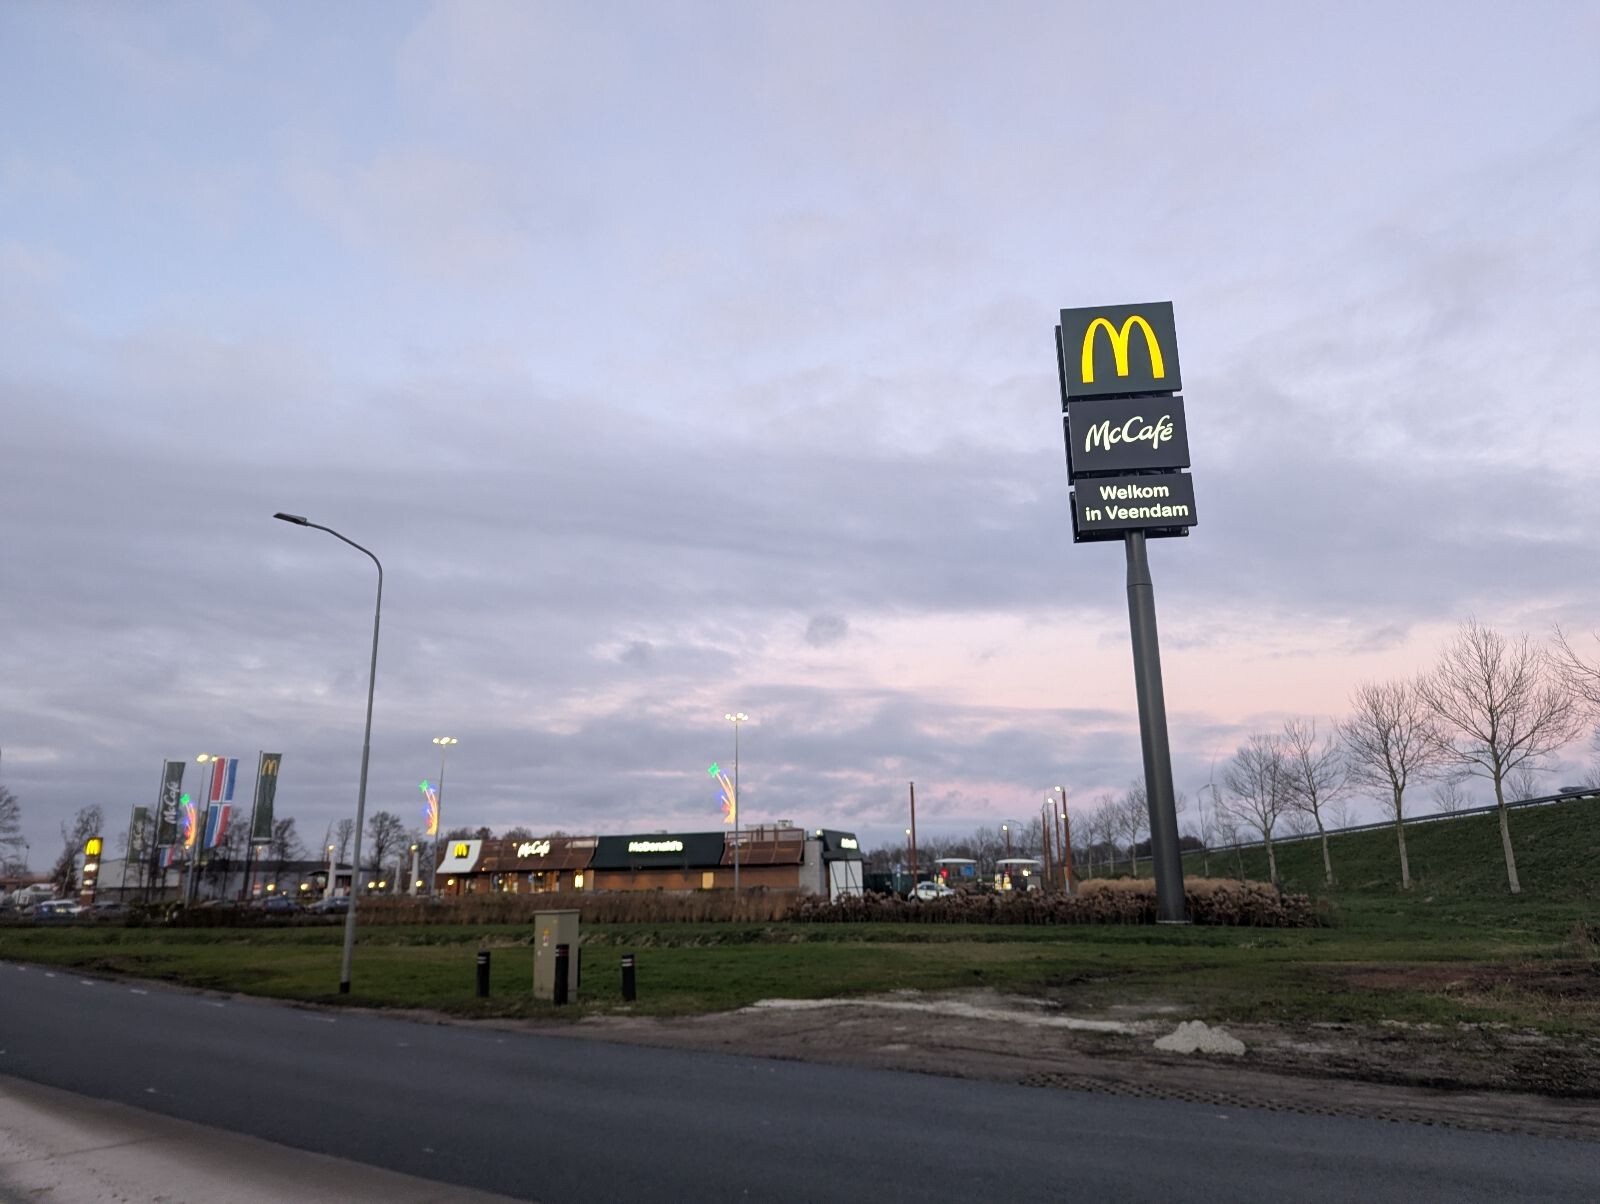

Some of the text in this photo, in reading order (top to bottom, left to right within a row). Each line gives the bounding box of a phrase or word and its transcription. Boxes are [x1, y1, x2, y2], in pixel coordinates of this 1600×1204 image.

[1085, 415, 1173, 452] McCafé
[1100, 484, 1169, 500] Welkom
[1085, 503, 1189, 521] in Veendam
